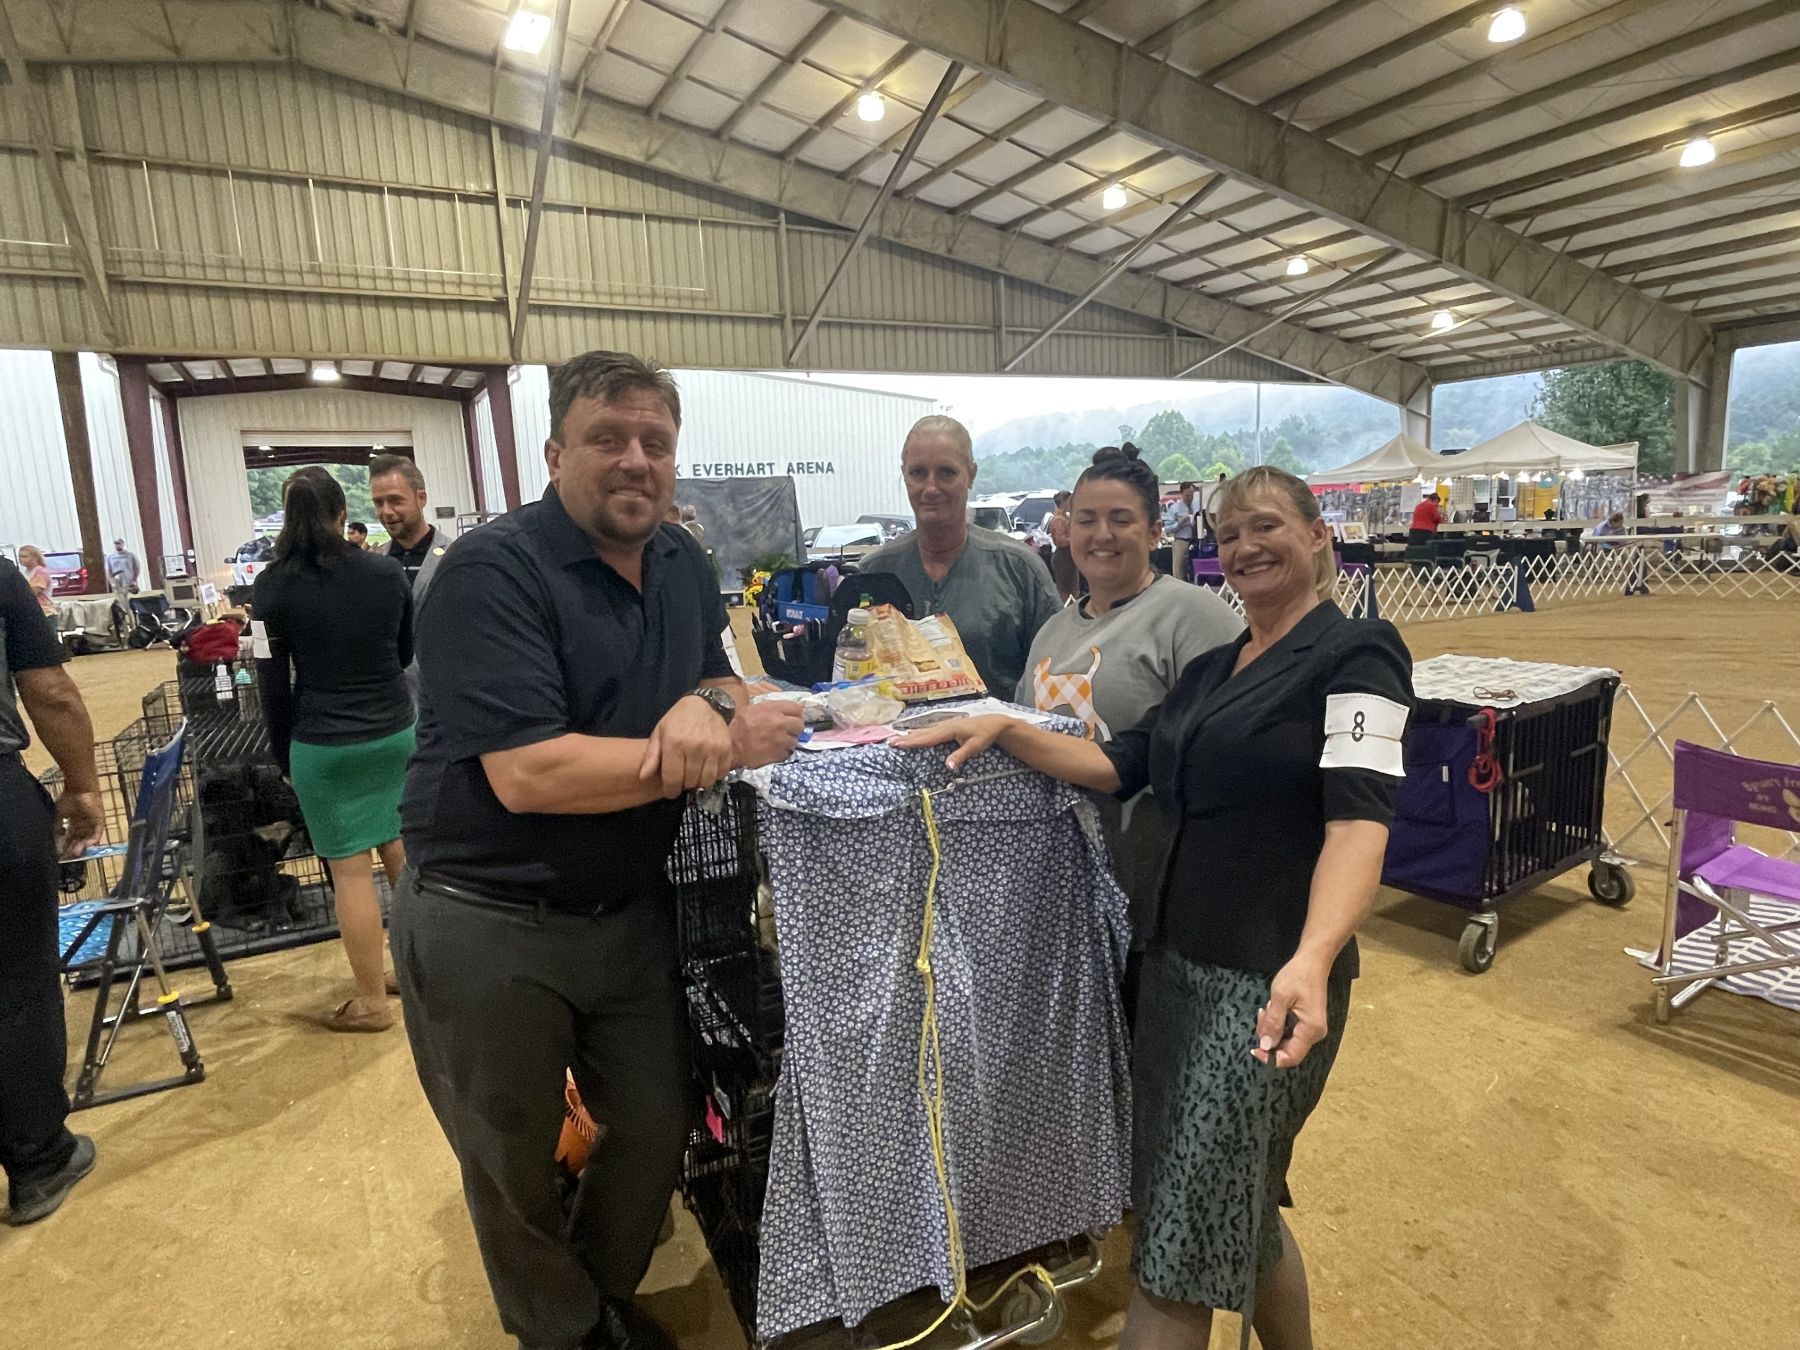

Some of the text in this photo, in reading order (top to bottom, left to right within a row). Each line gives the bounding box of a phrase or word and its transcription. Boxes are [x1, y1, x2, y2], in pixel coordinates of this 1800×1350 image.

[692, 463, 775, 476] EVERHART
[786, 462, 834, 475] ARENA
[1352, 711, 1365, 742] 8
